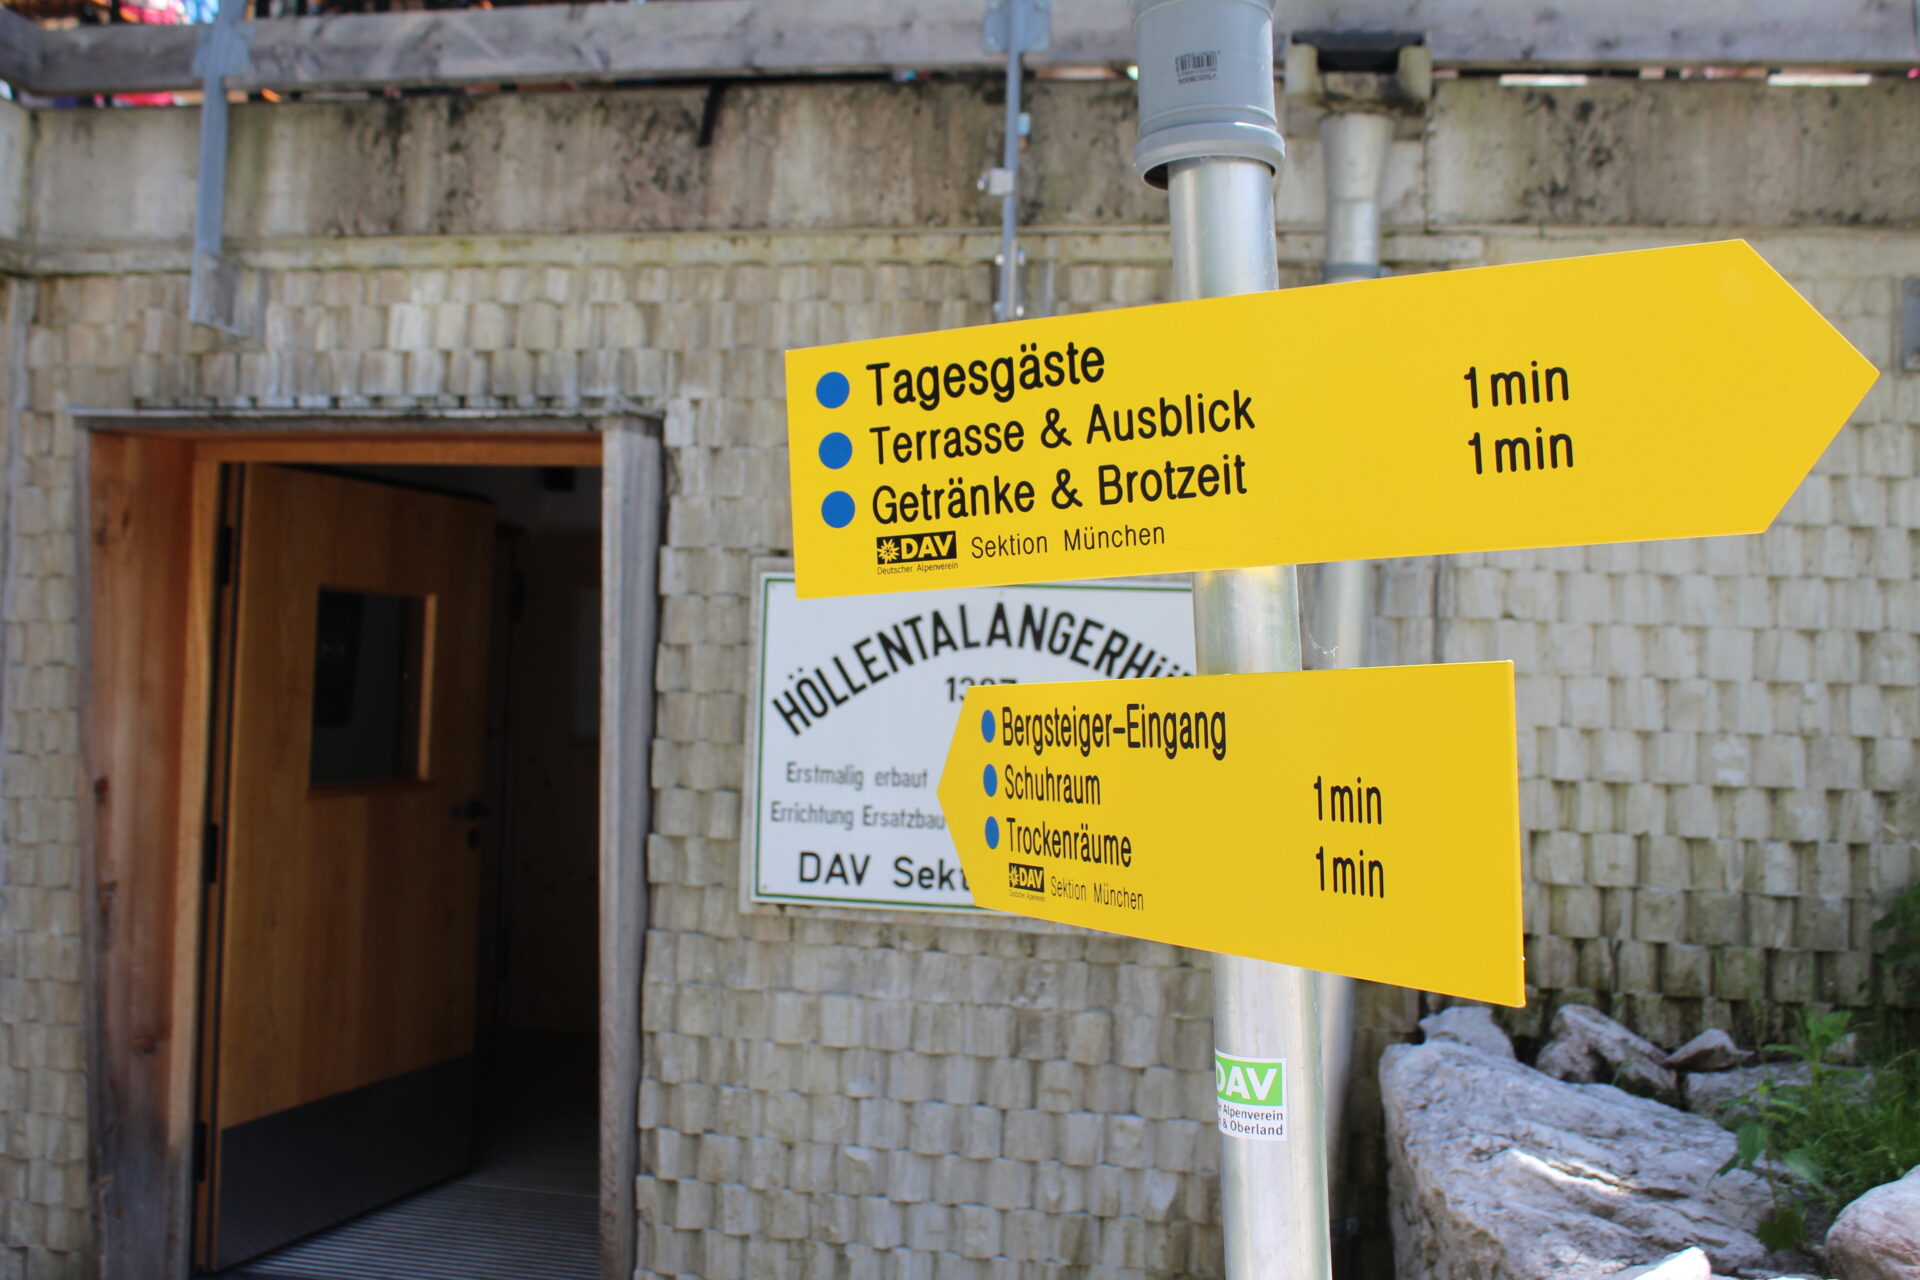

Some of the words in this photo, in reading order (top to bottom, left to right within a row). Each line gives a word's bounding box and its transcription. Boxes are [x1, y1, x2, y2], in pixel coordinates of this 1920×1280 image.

[866, 342, 1104, 411] Tagesgäste
[869, 421, 1024, 464] Terrasse
[1041, 408, 1072, 448] &
[1087, 390, 1255, 444] Ausblick
[873, 476, 1034, 524] Getränke
[1052, 469, 1083, 509] &
[1099, 454, 1247, 505] Brotzeit
[901, 534, 954, 559] DAV
[972, 535, 1047, 558] Sektion
[1064, 525, 1164, 551] München
[877, 564, 913, 576] Deutscher
[917, 561, 959, 572] Alpenverein
[1003, 704, 1226, 760] Bergsteiger-Eingang
[786, 761, 864, 791] Erstmalig
[875, 767, 928, 788] erbaut
[1005, 765, 1100, 804] Schuhraum
[771, 801, 854, 831] Errichtung
[1007, 818, 1131, 867] Trockenräume
[799, 851, 871, 886] DAV
[1020, 867, 1044, 889] DAV
[1051, 876, 1087, 902] Sektion
[1094, 882, 1144, 911] München
[1216, 1059, 1278, 1101] DAV
[1223, 1103, 1283, 1121] Alpenverein
[1230, 1120, 1283, 1136] Oberland
